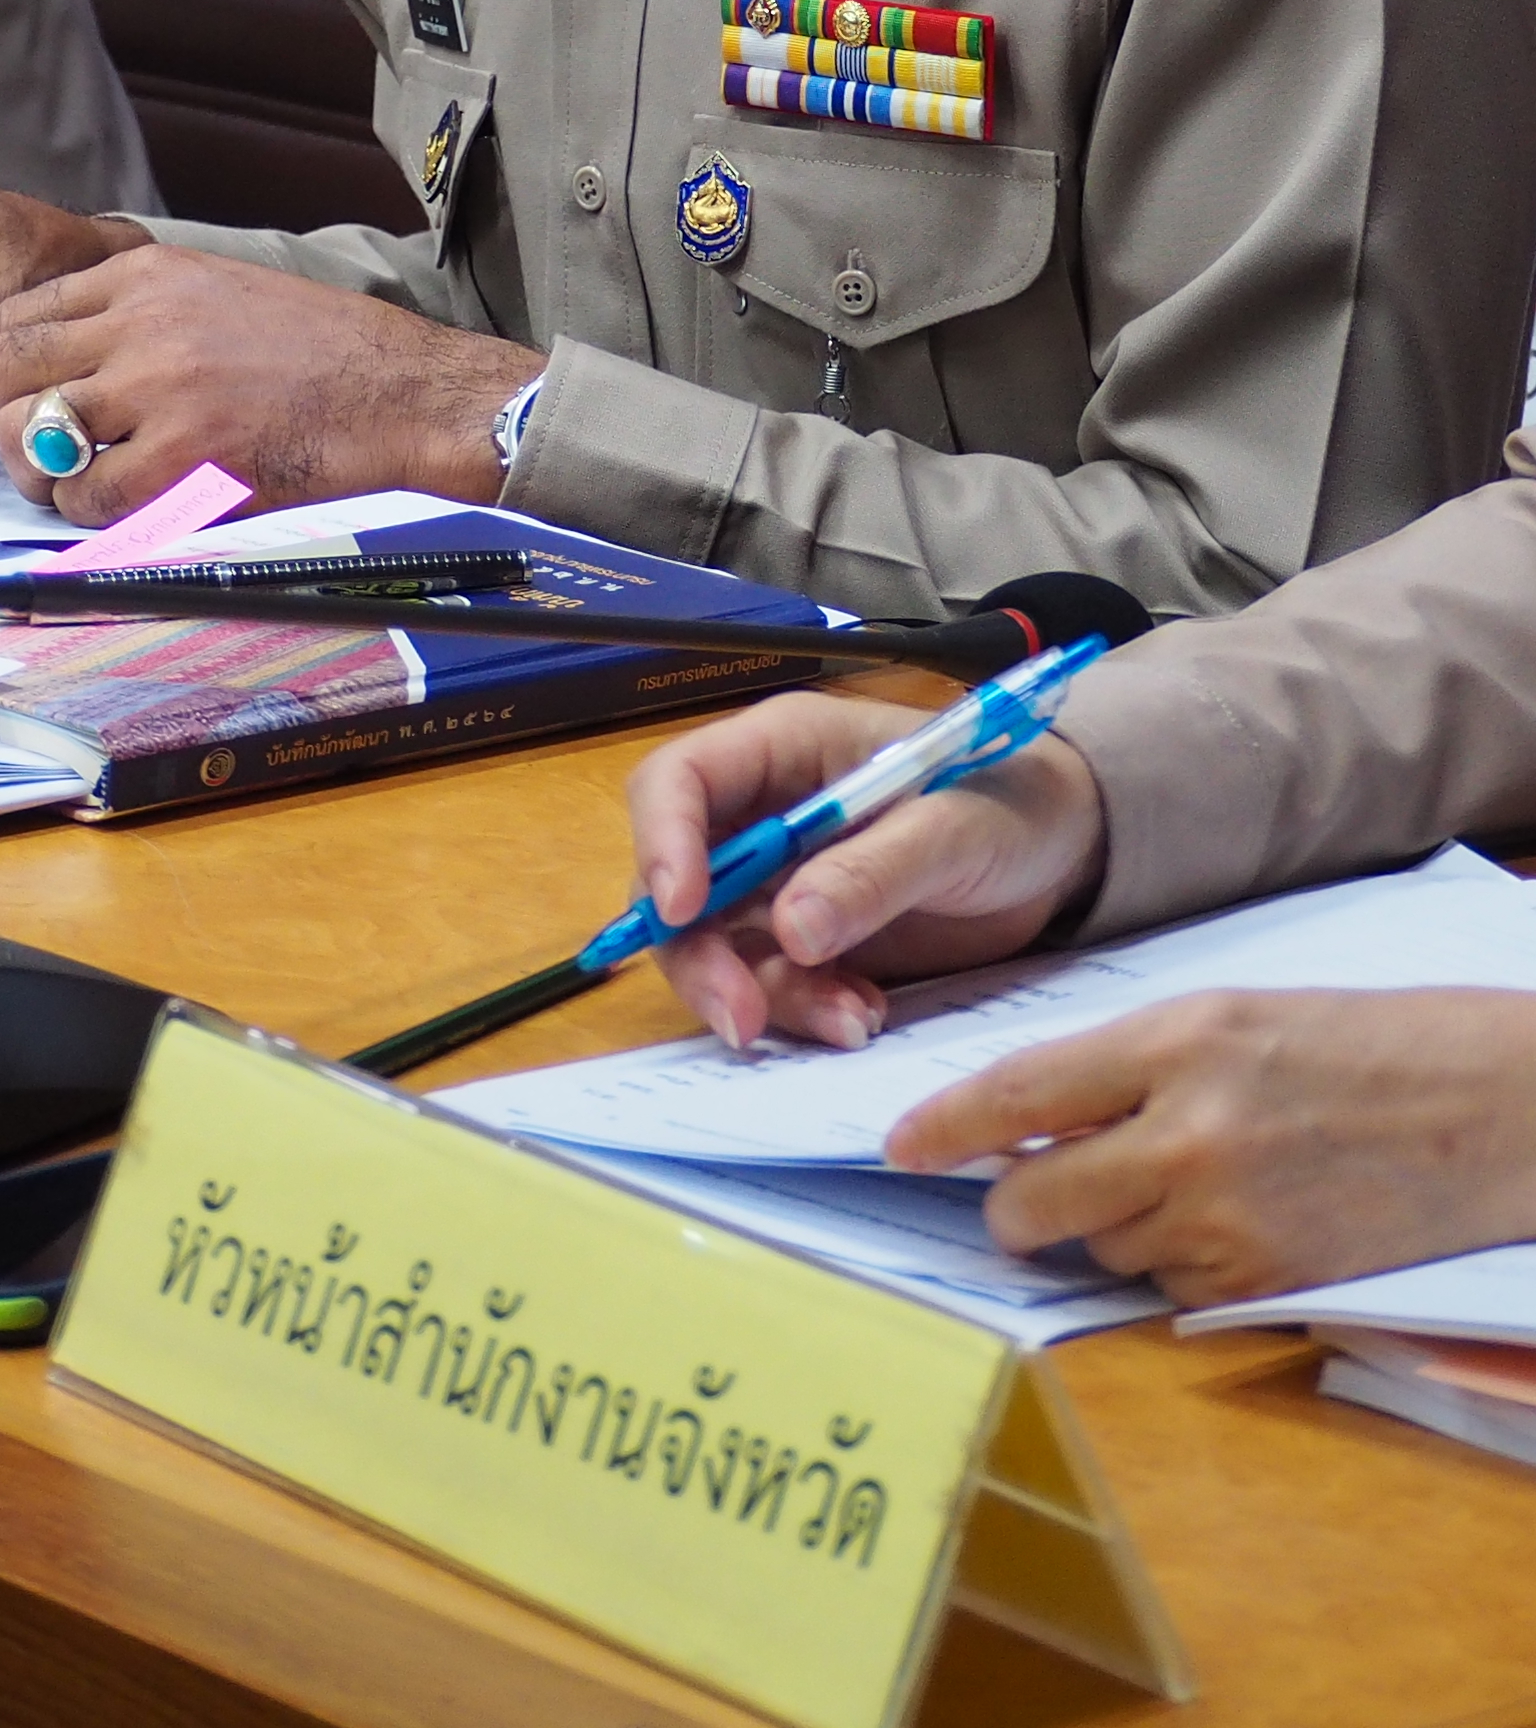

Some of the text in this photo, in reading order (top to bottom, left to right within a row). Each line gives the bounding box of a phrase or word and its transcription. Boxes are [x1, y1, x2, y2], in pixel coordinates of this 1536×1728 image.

[636, 653, 782, 692] กรมการพัฒนาชุมชน
[266, 728, 390, 767] บันทึกนักพัฒนา
[158, 1179, 889, 1569] หัวหน้าสำนักงานจังหวัด
